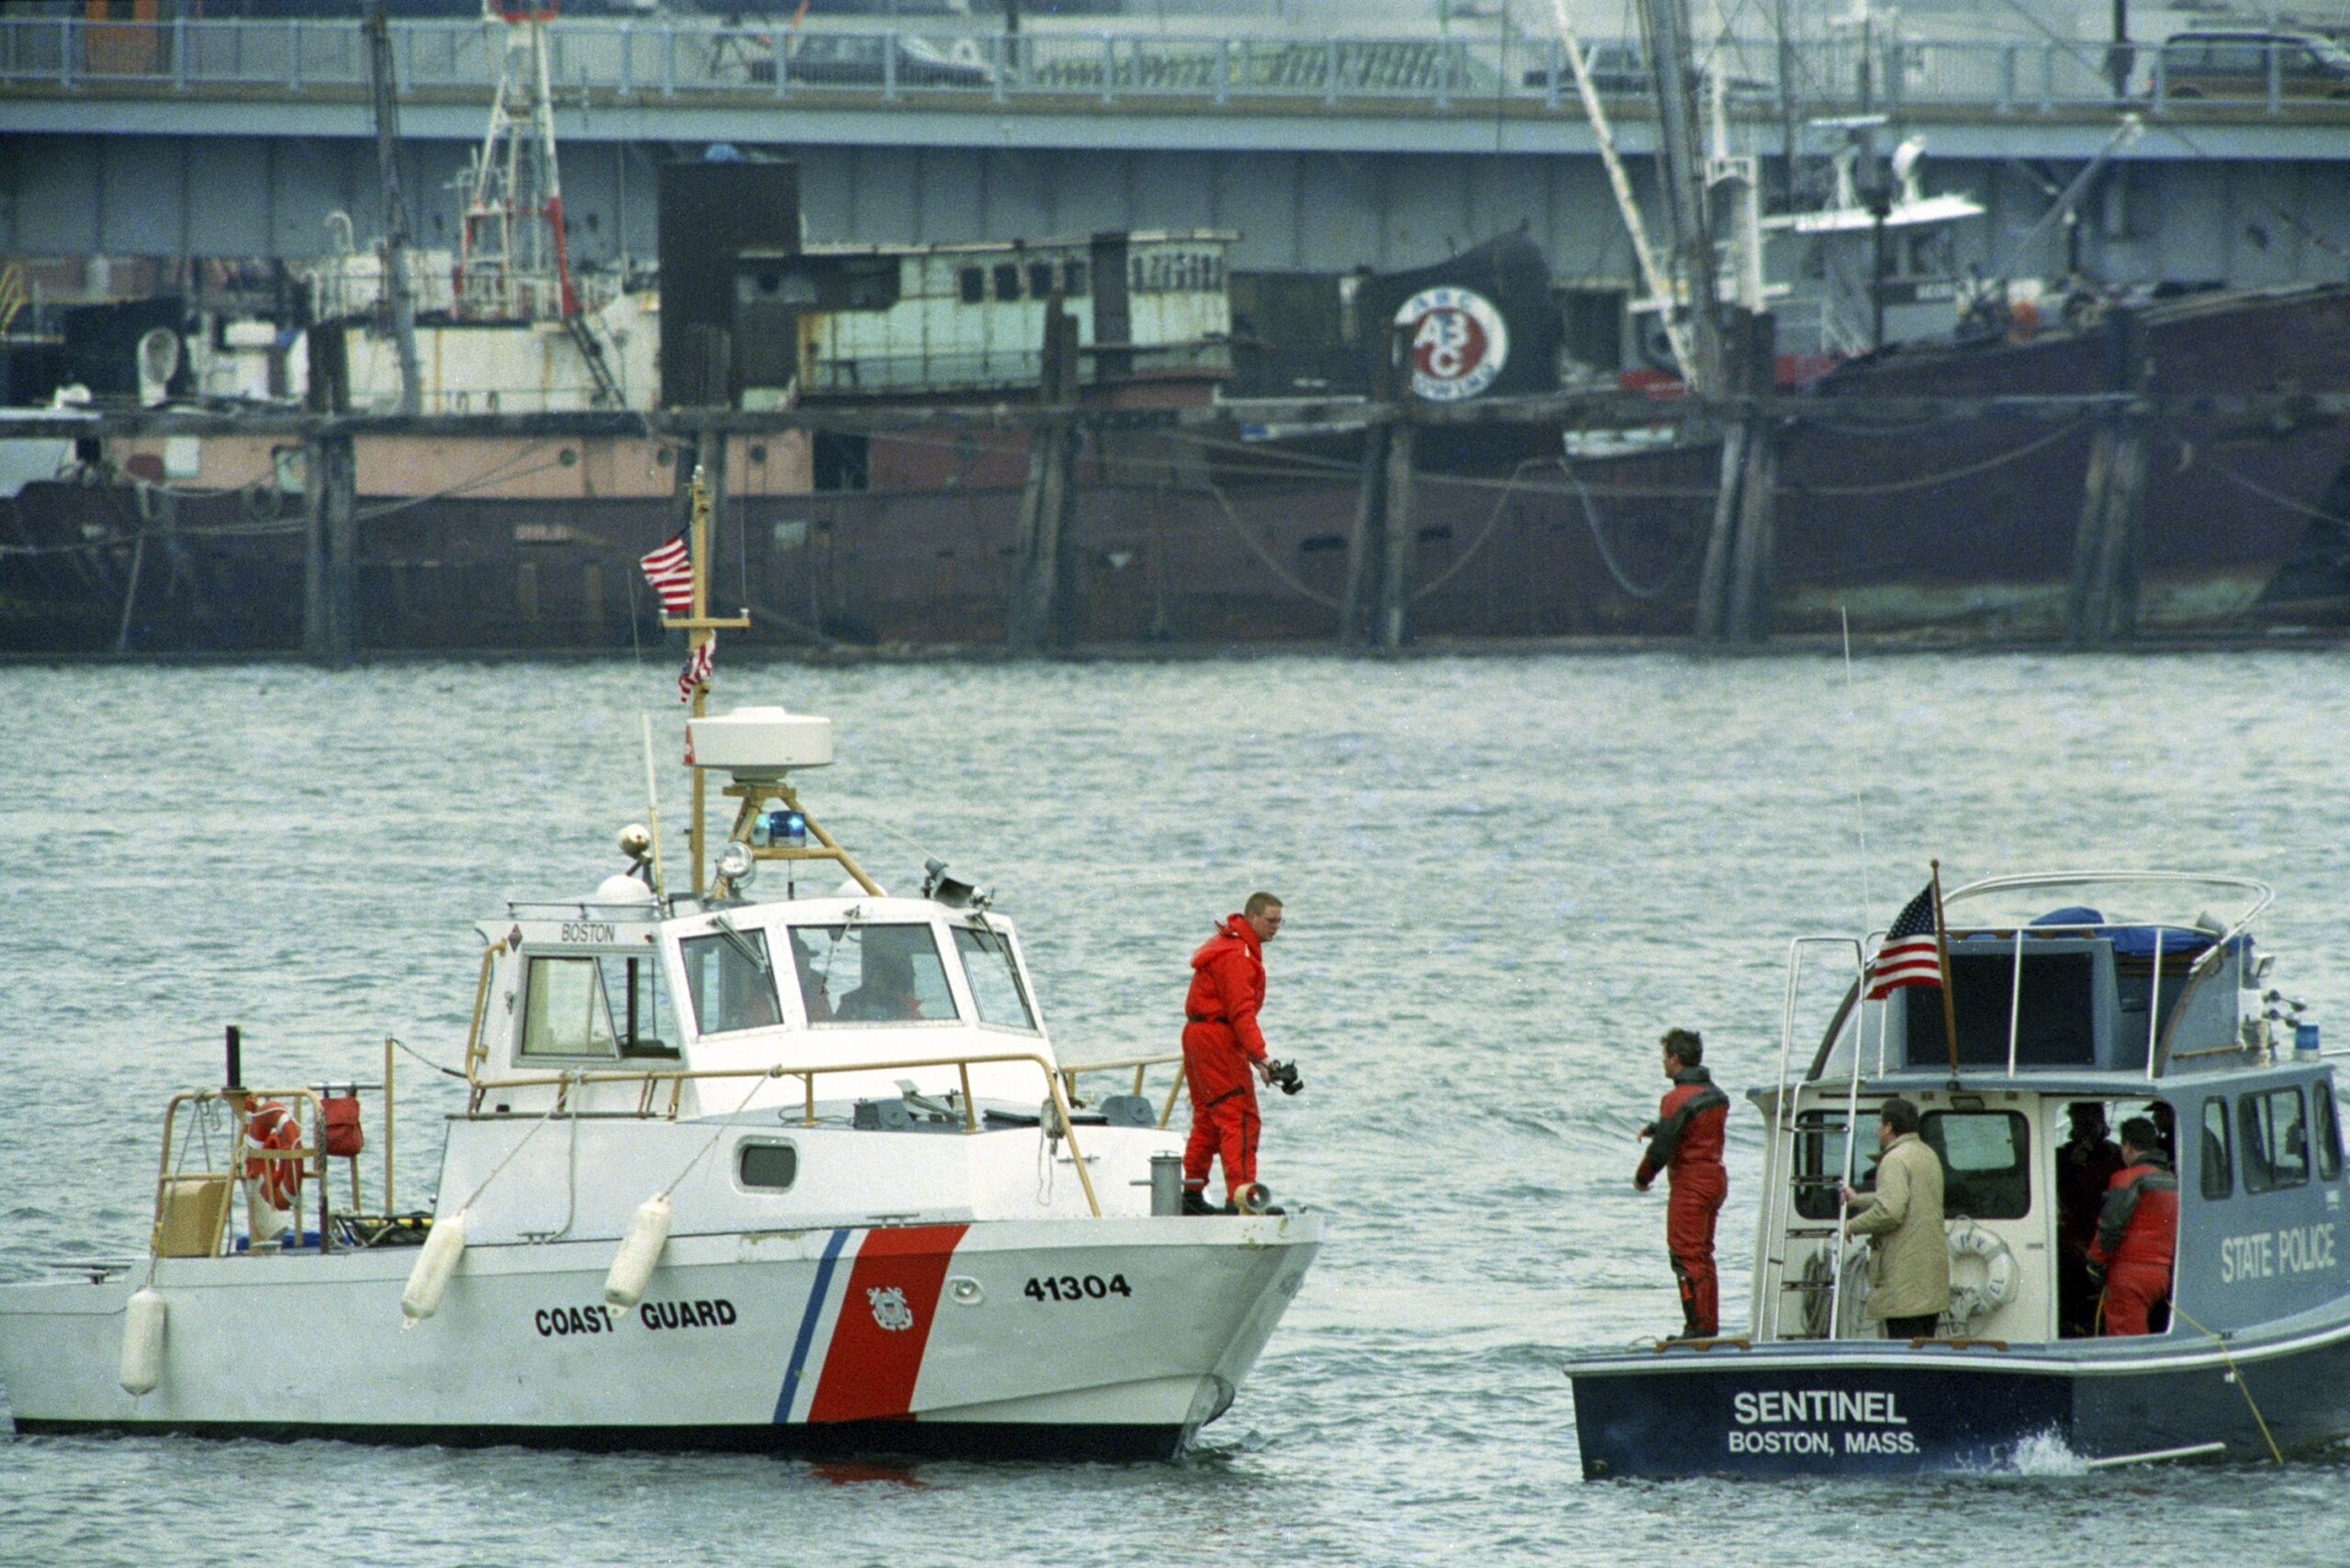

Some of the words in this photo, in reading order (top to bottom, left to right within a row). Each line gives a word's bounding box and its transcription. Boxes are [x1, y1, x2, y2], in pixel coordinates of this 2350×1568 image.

[562, 923, 615, 943] BOSTON
[2221, 1232, 2273, 1283] STATE
[2278, 1222, 2336, 1274] POLICE
[1024, 1273, 1133, 1302] 41304
[535, 1305, 613, 1338] COAST
[641, 1299, 737, 1330] GUARD
[1733, 1390, 1908, 1424] SENTINEL
[1728, 1430, 1835, 1457] BOSTON,
[1844, 1430, 1921, 1454] MASS.
